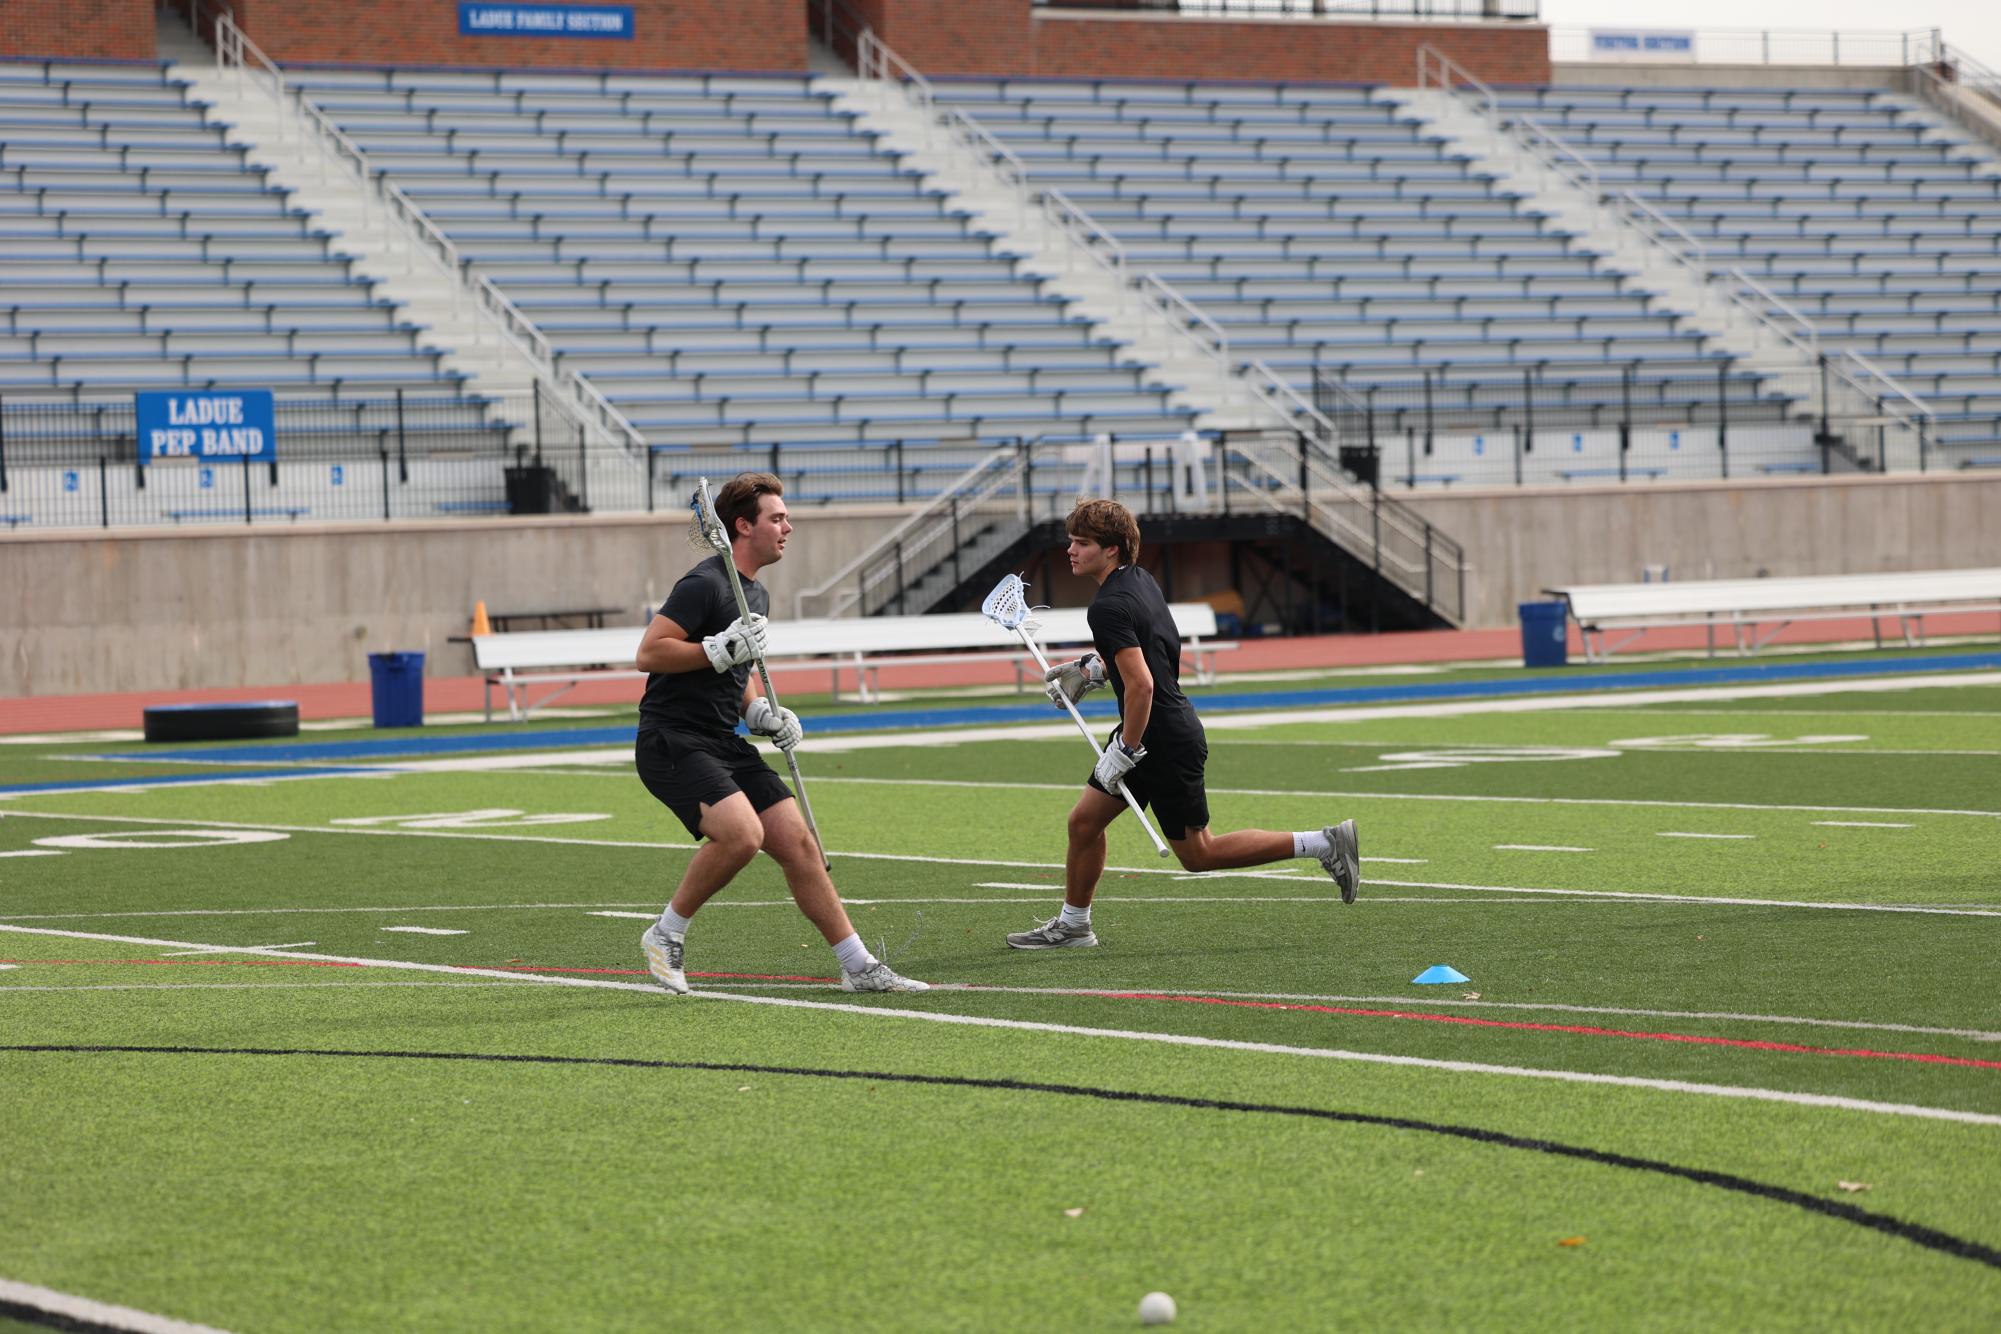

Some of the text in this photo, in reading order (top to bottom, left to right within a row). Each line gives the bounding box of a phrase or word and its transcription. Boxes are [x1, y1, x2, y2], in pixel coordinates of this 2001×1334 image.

[168, 397, 244, 425] LADUE
[151, 427, 263, 456] PEP BAND
